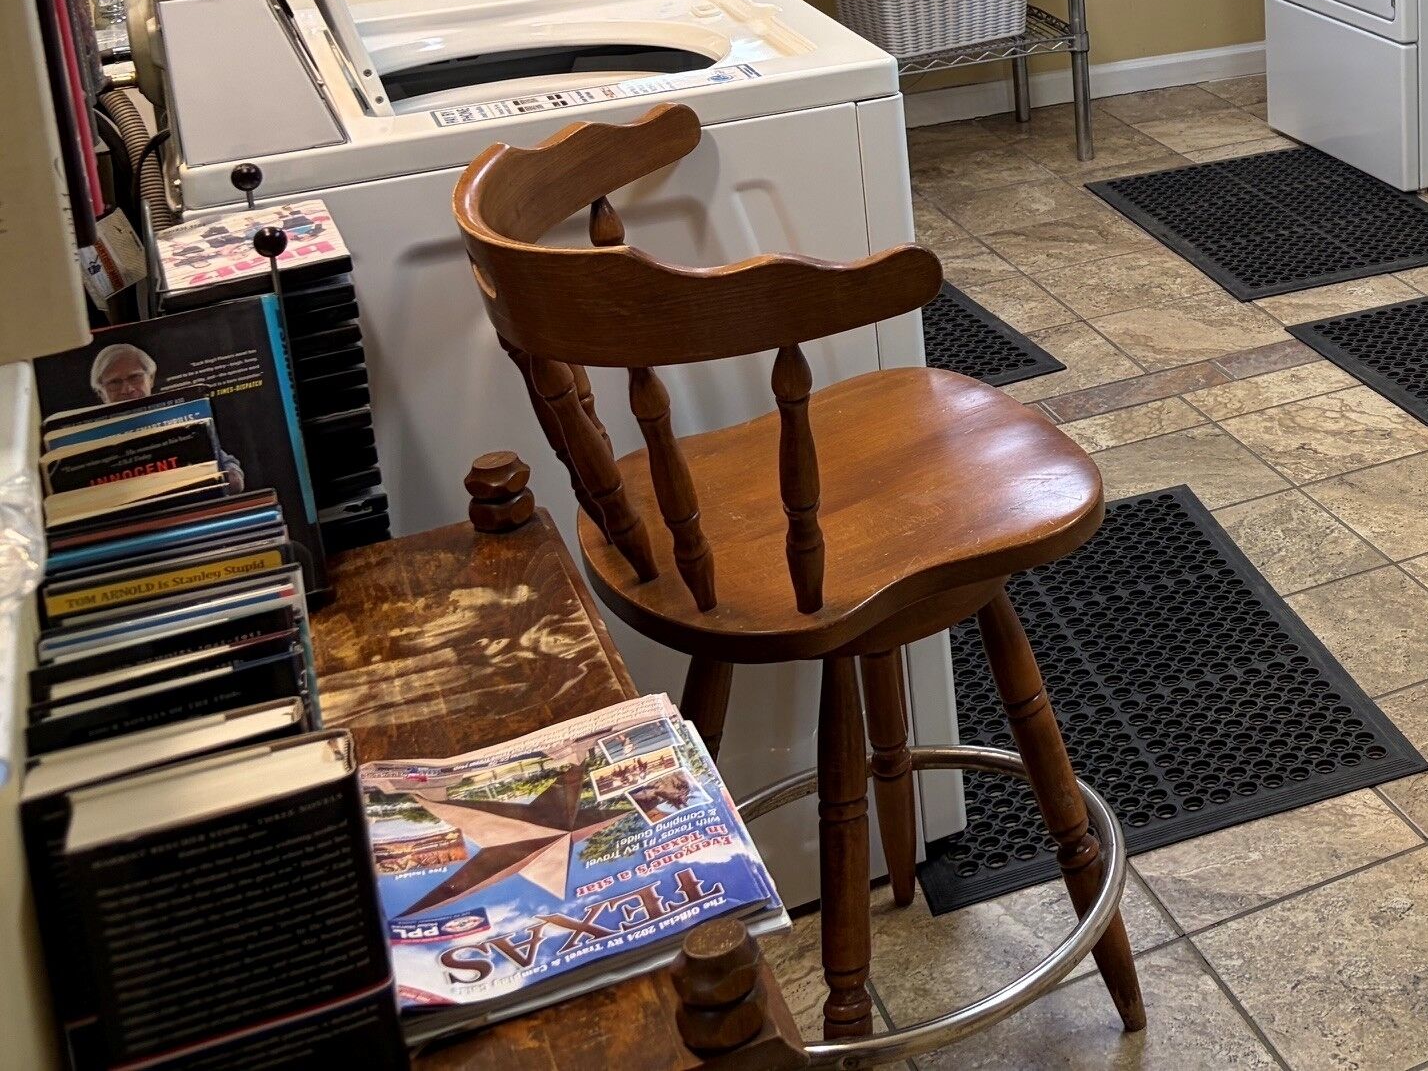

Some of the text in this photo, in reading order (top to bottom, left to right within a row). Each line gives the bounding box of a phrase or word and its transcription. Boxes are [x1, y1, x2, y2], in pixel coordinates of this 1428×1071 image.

[90, 456, 178, 486] INNOCENT
[65, 596, 97, 609] TOM
[101, 584, 155, 604] ARNOLD
[172, 569, 222, 588] Stanley
[224, 560, 264, 578] Stupid
[655, 812, 705, 832] Camping
[696, 816, 720, 828] with
[616, 828, 650, 848] Guide!
[643, 836, 656, 848] #1
[644, 824, 728, 860] in Texas!
[624, 842, 641, 854] RV
[576, 834, 733, 898] Everyone's a star
[586, 850, 622, 868] Travel
[703, 896, 727, 910] The
[439, 867, 725, 984] TEXAS
[659, 907, 700, 930] Official
[392, 926, 440, 938] PPL
[626, 924, 656, 942] 2024
[606, 937, 624, 948] RV
[551, 958, 562, 966] &
[564, 945, 604, 963] Travel
